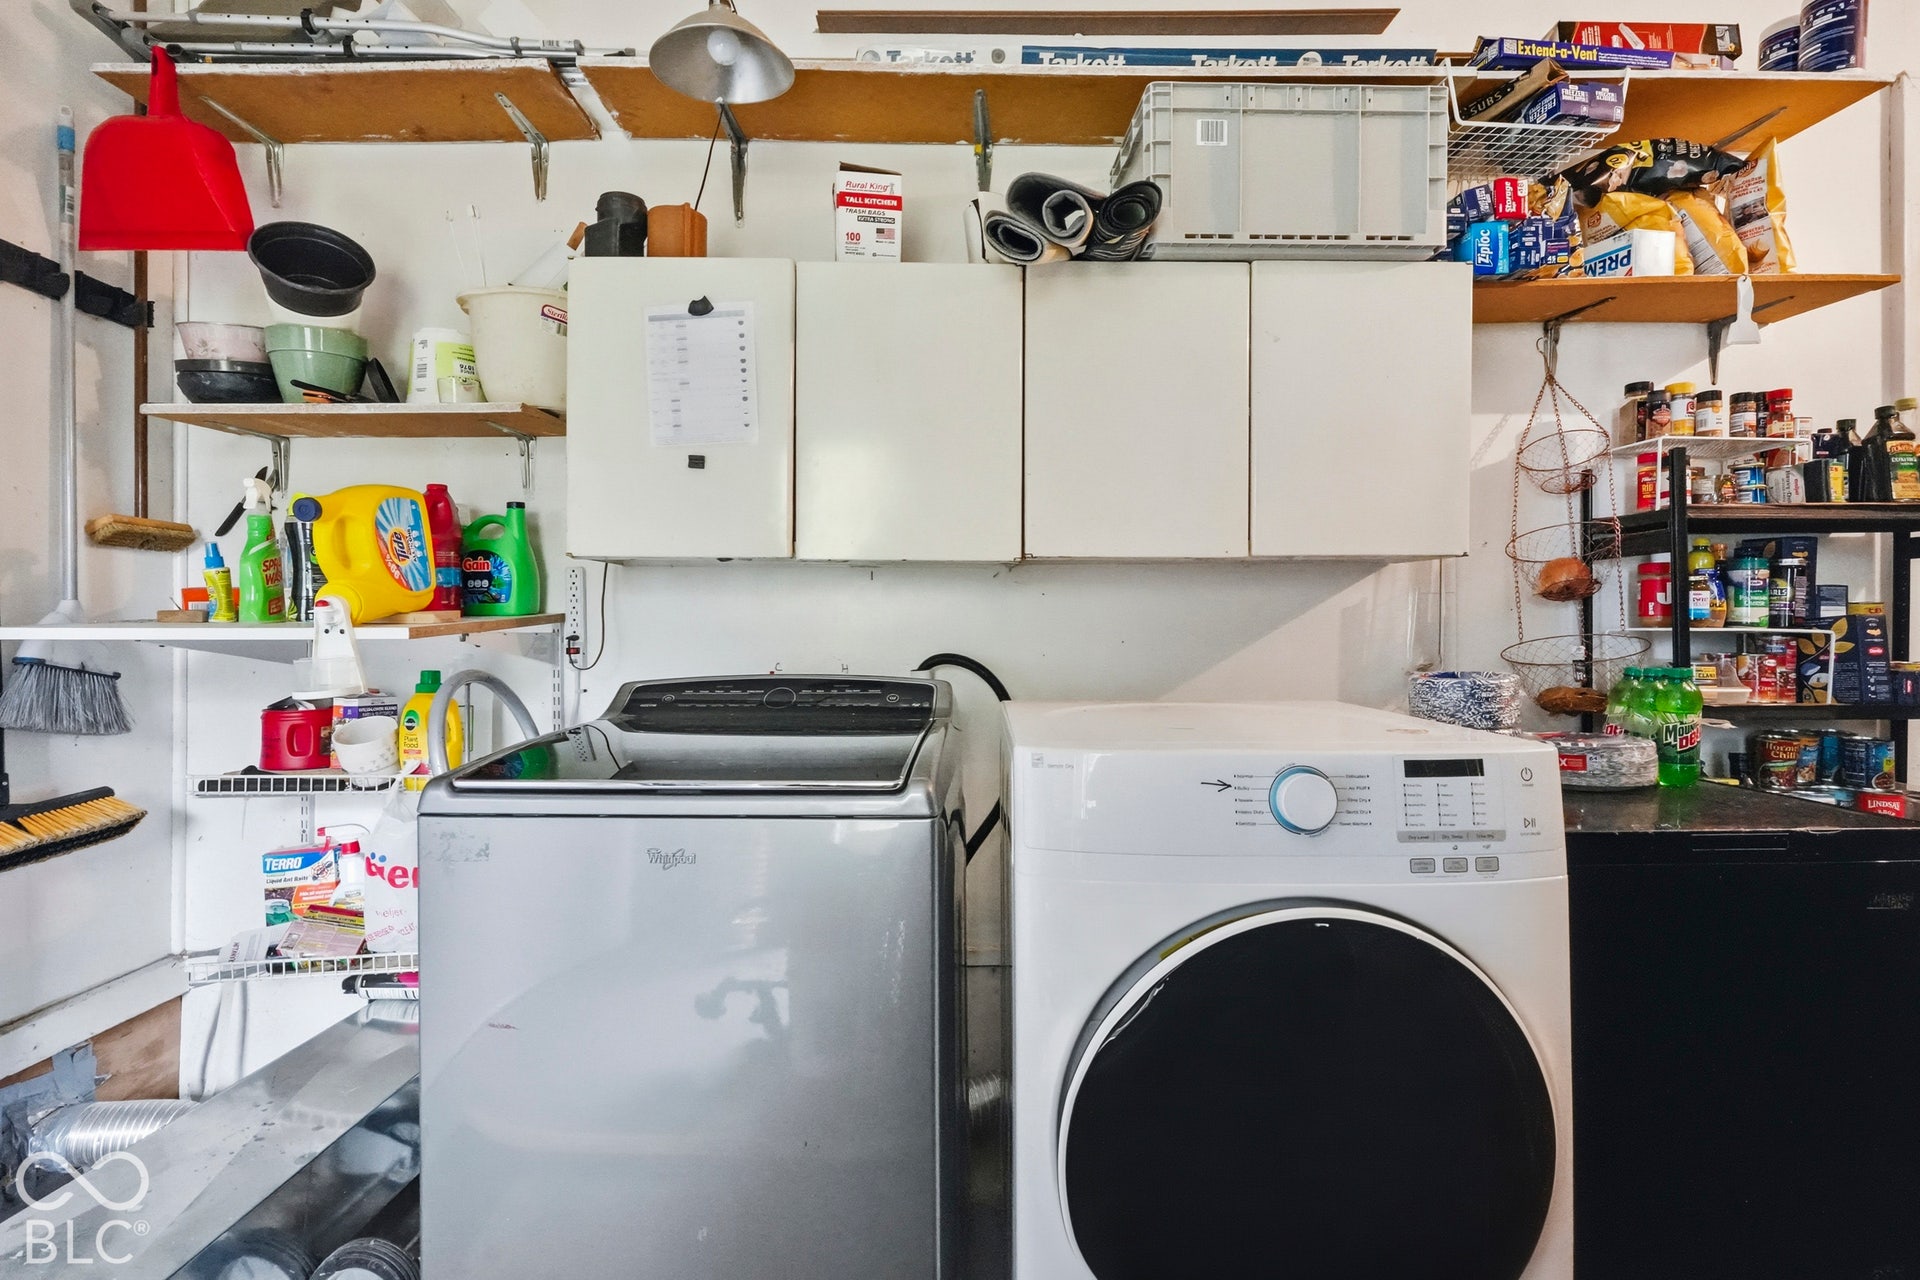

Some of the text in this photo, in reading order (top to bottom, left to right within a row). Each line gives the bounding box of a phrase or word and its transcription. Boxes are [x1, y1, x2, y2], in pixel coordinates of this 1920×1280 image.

[1517, 40, 1598, 62] Extend-a-Vent
[1470, 91, 1502, 115] SUBS
[845, 180, 889, 192] Rural King
[845, 196, 897, 206] TALL KITCHEN
[1504, 181, 1514, 213] Storage
[845, 207, 866, 215] TRASH
[845, 231, 861, 242] 100
[1477, 229, 1493, 265] Ziploc
[392, 531, 410, 562] Tide
[462, 556, 492, 572] Gain
[775, 662, 783, 672] C
[841, 664, 849, 674] H
[403, 741, 419, 749] Food
[1770, 750, 1797, 760] Chili
[1868, 799, 1900, 811] LINDSAY
[263, 857, 302, 872] TERRO
[646, 847, 697, 871] Whirlpool
